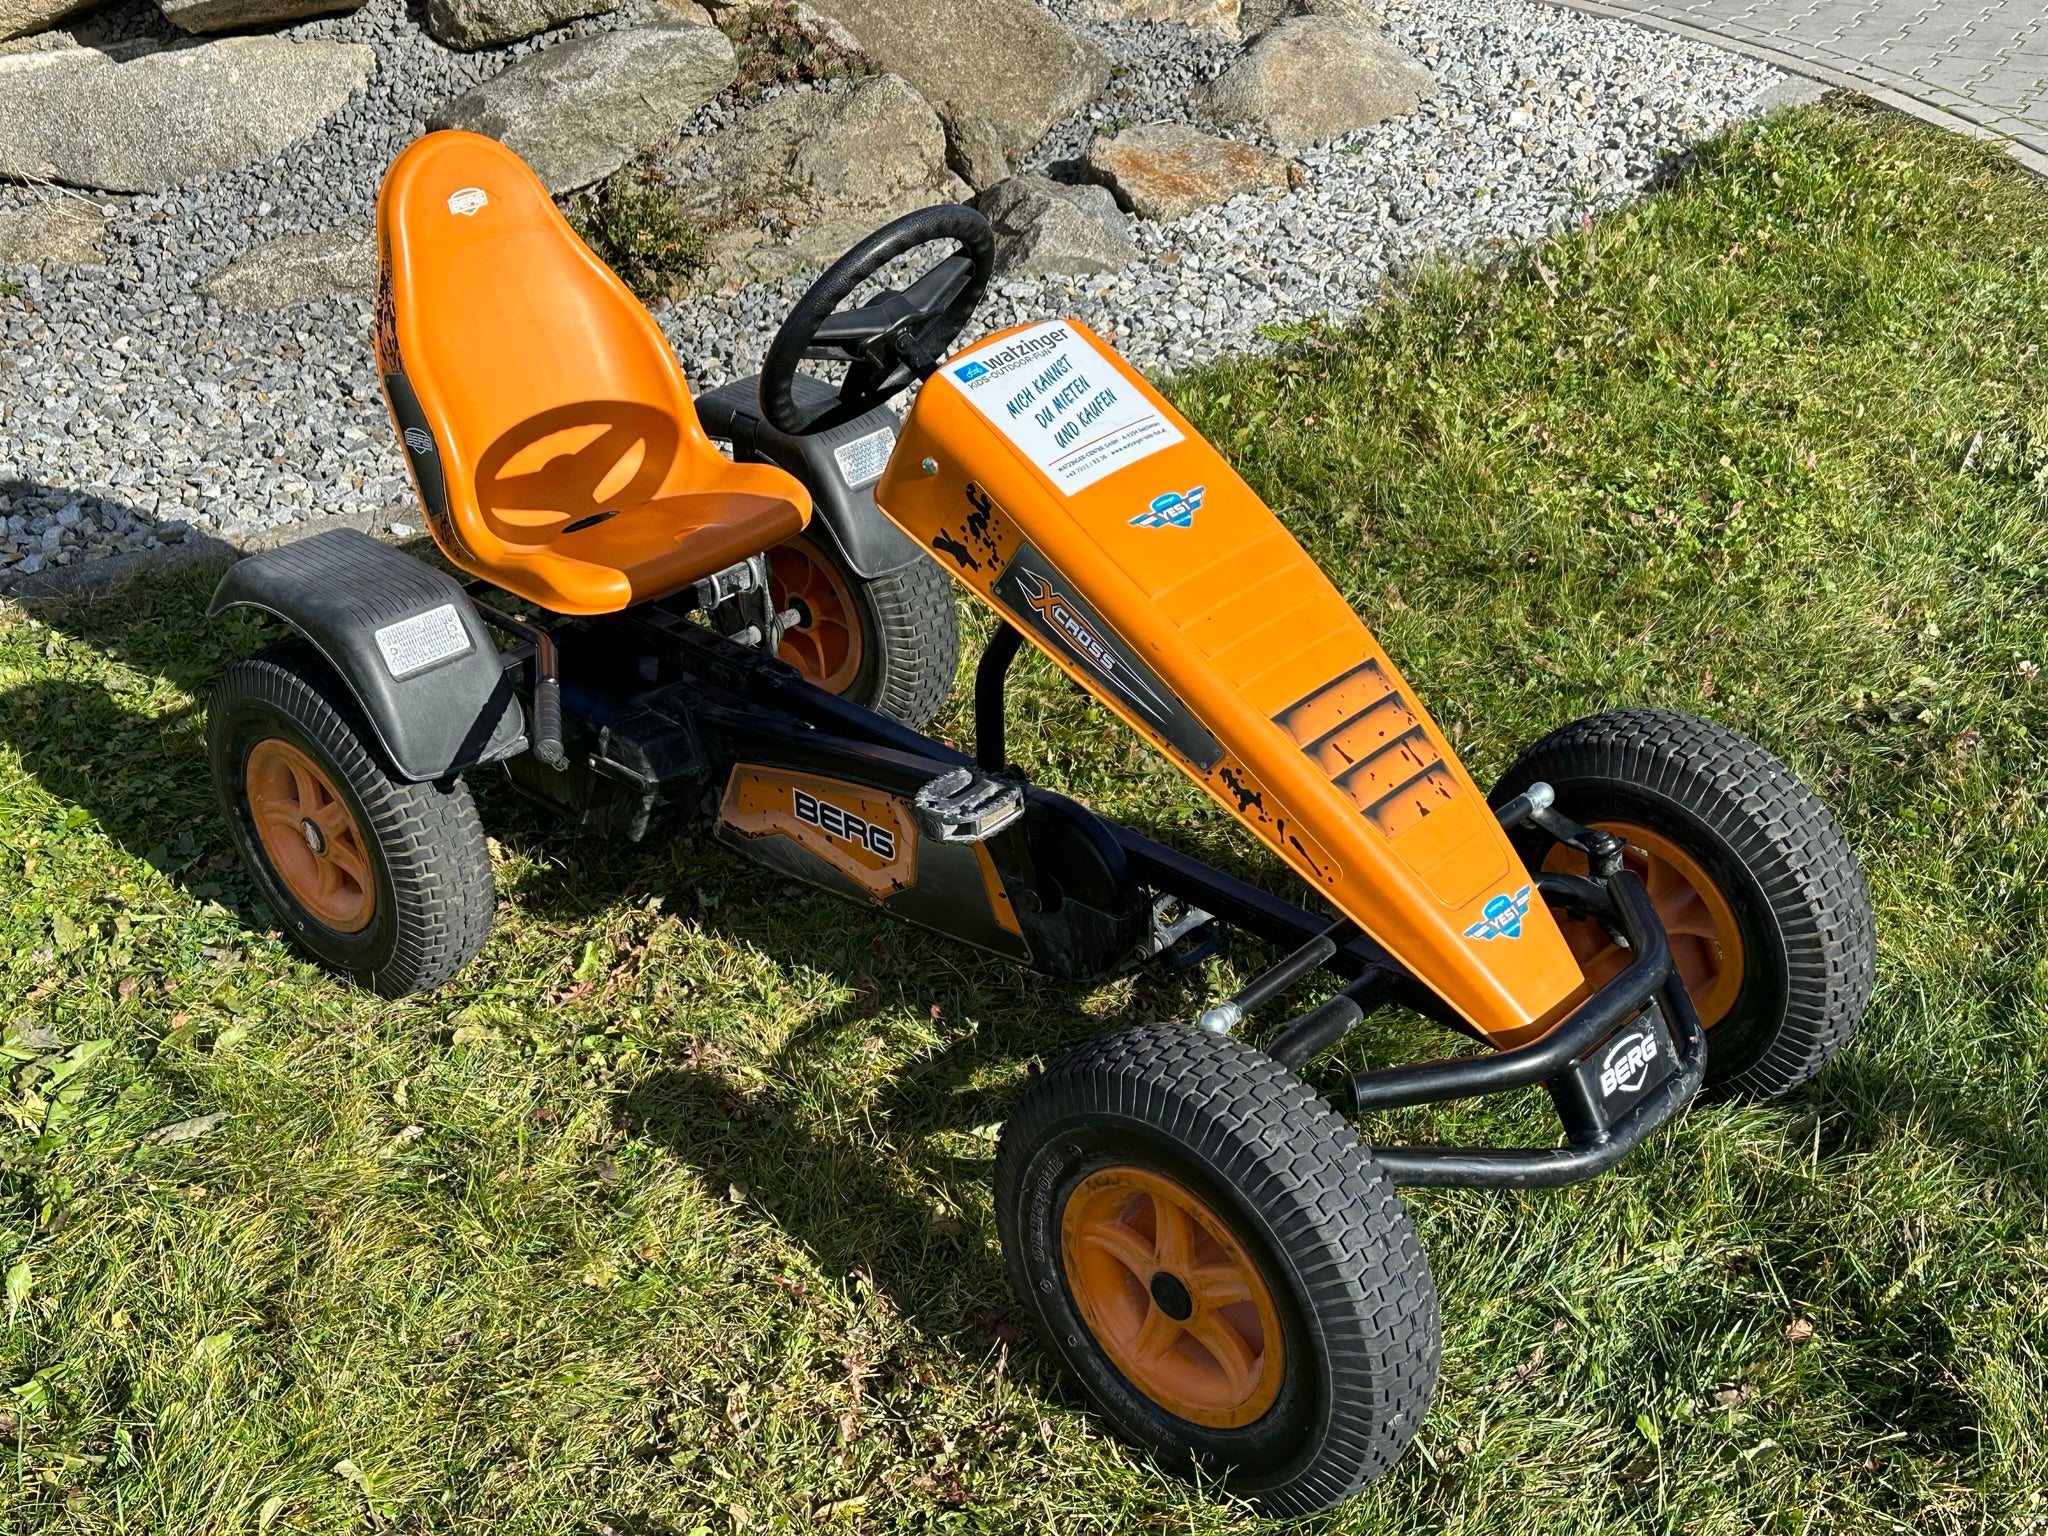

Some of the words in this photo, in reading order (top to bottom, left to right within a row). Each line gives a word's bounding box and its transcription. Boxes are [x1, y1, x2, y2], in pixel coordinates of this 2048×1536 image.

[447, 190, 488, 214] BERG
[968, 348, 1053, 390] KIDS-OUTDOOR-FUN
[982, 328, 1069, 370] watzinger
[1006, 386, 1036, 419] MICH
[1032, 353, 1073, 394] KANNST
[1034, 405, 1056, 429] DU
[1052, 374, 1091, 415] MIETEN
[404, 430, 433, 452] BERG
[1054, 421, 1080, 448] UND
[1076, 387, 1118, 427] KAUFEN
[792, 786, 896, 861] BERG
[1600, 1033, 1658, 1097] BERG
